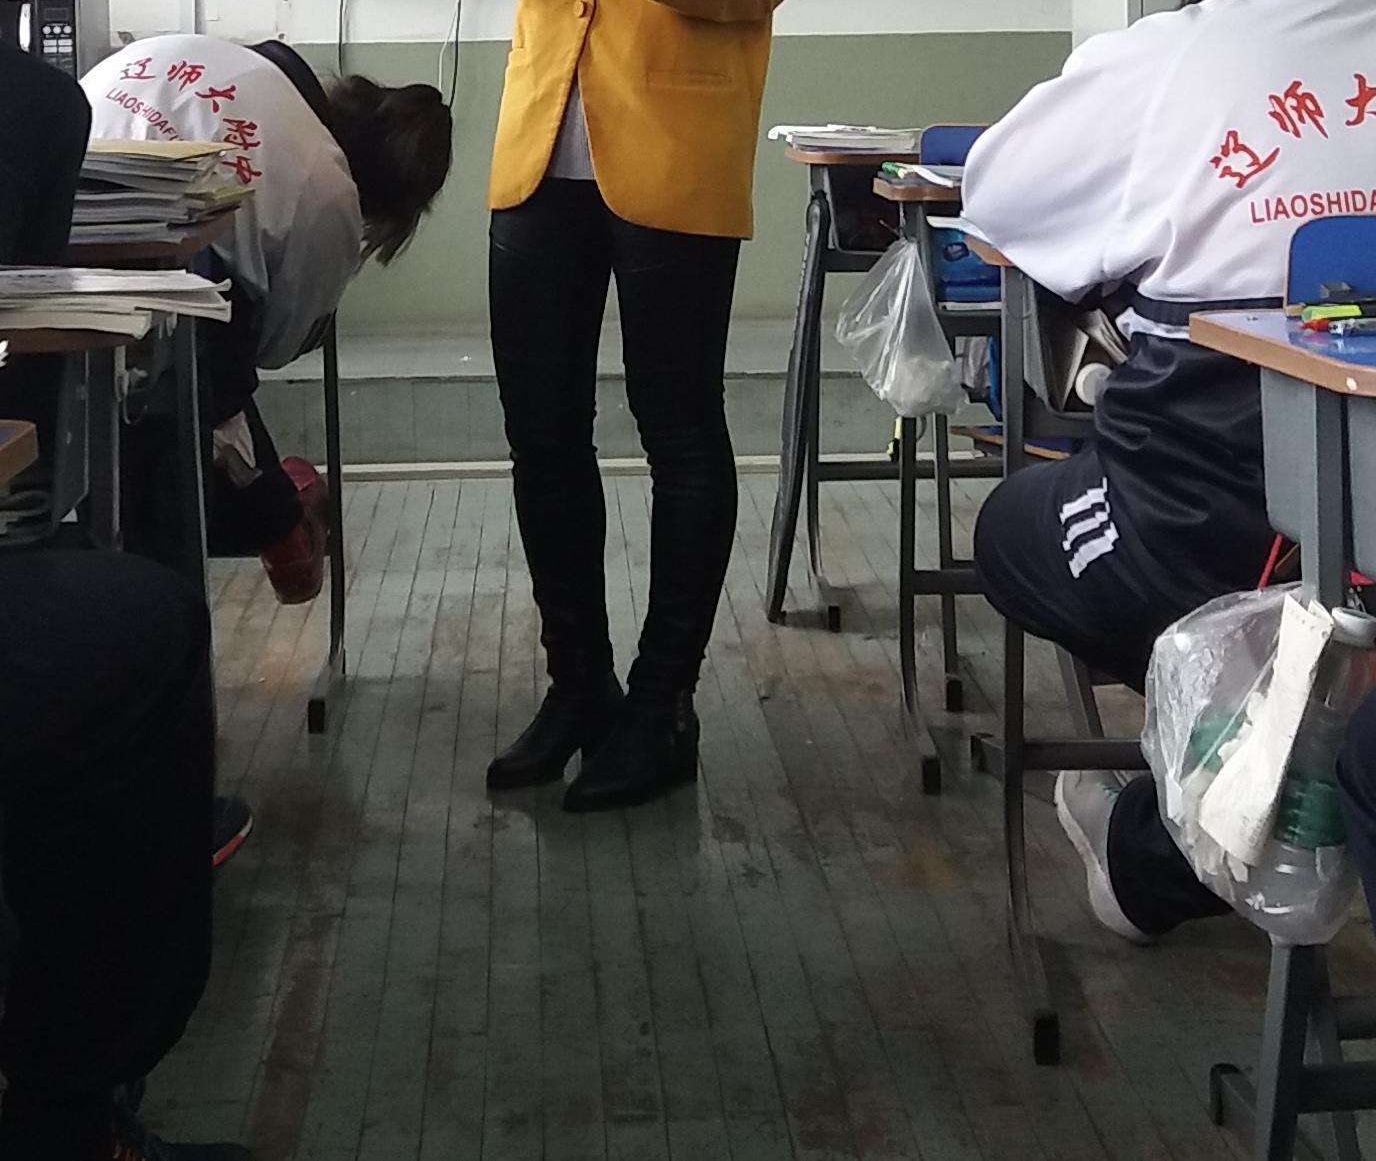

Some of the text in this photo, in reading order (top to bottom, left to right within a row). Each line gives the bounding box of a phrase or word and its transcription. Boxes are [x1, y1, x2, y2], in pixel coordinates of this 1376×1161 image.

[105, 88, 185, 141] LIAOSHIDAF
[119, 56, 264, 185] 辽师大附中
